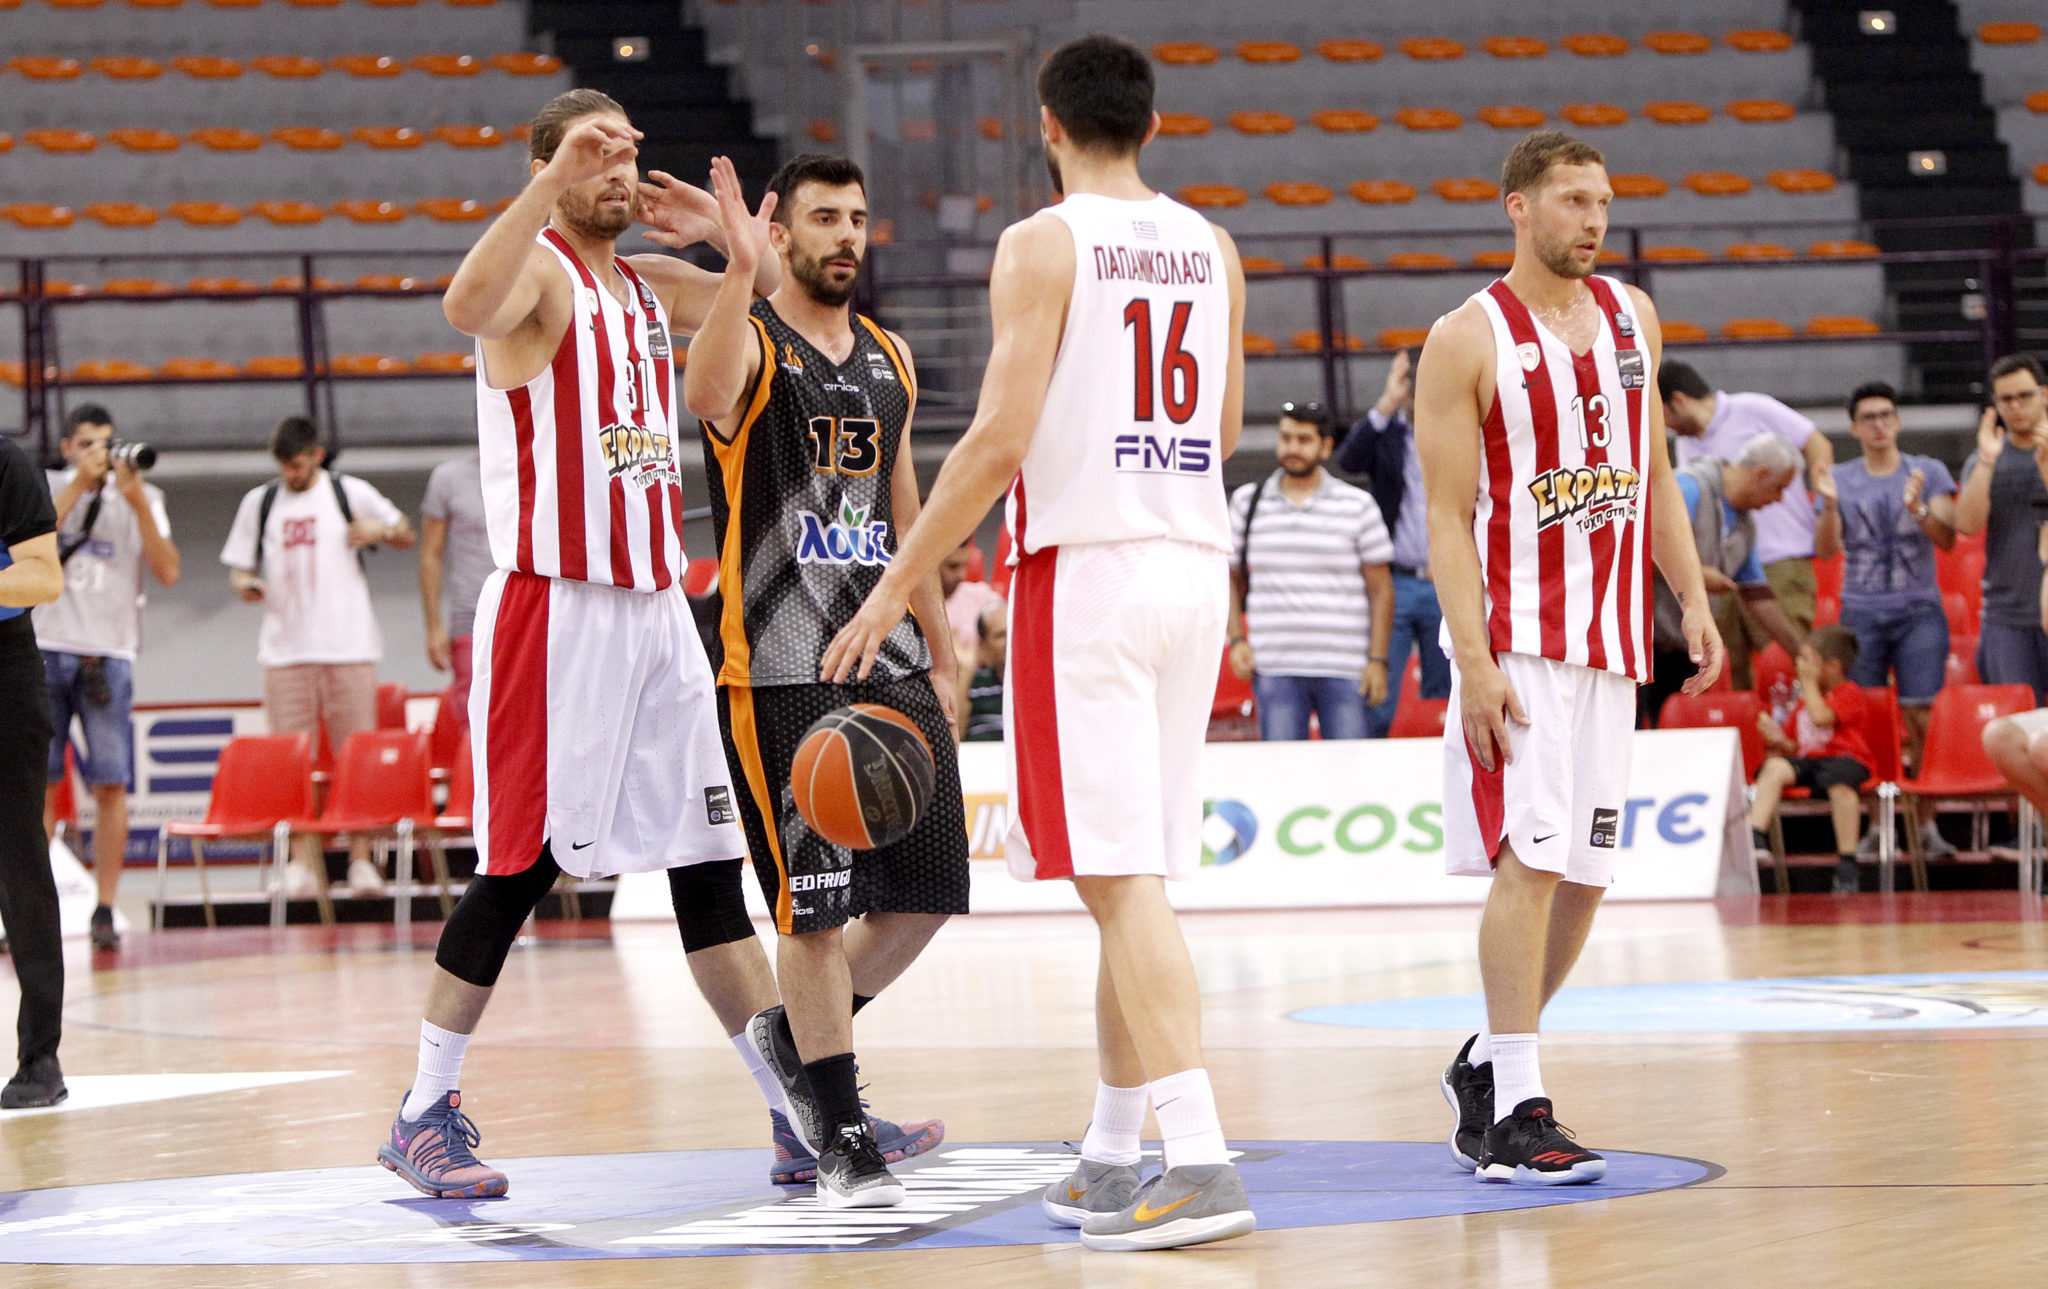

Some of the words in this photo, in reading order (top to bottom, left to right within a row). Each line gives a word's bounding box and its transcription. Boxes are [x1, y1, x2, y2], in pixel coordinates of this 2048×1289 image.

[626, 358, 650, 412] 31
[1123, 297, 1198, 424] 16
[808, 415, 881, 477] 13
[1571, 393, 1612, 449] 13
[1115, 434, 1211, 472] FMS
